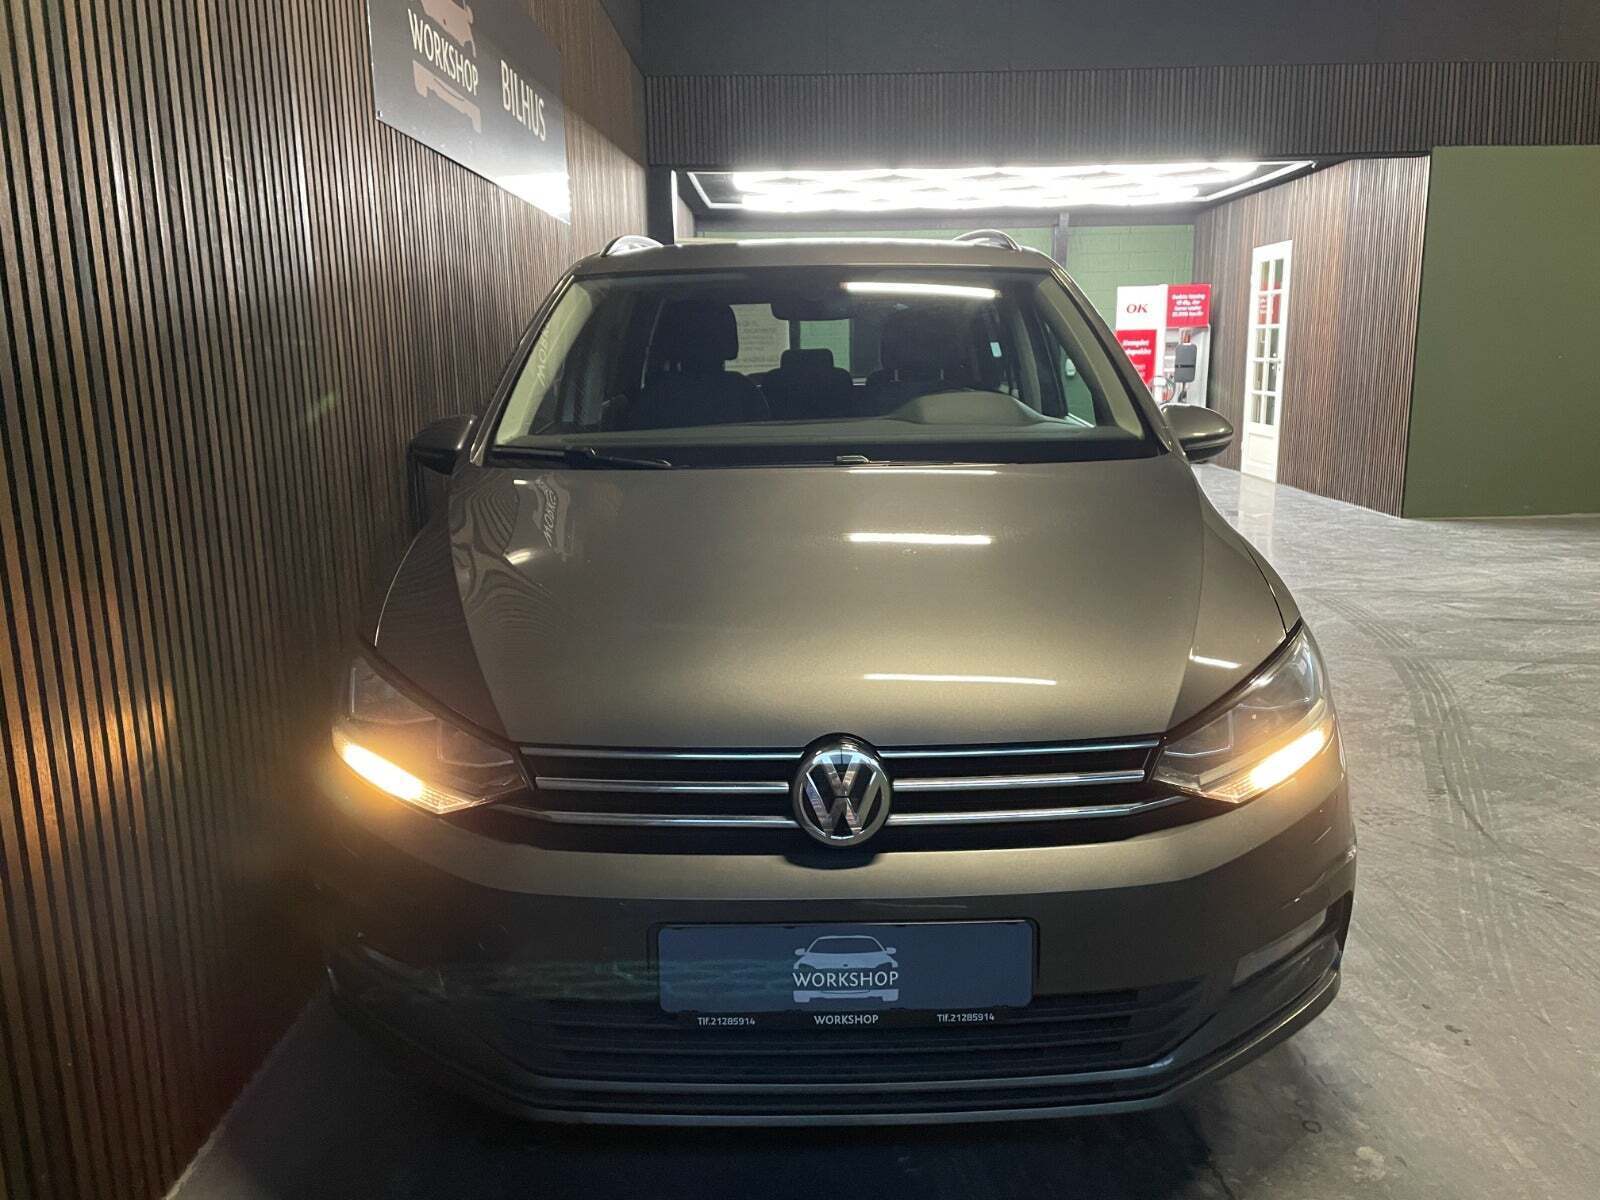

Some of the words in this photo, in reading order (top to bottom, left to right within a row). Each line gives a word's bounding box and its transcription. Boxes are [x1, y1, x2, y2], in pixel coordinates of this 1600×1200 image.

[408, 8, 479, 96] WORKSHOP
[500, 60, 547, 142] BILHUS
[1126, 303, 1149, 314] OK
[792, 970, 900, 989] WORKSHOP
[697, 1016, 756, 1027] Tlf.21285914
[813, 1014, 880, 1026] WORKSHOP
[936, 1012, 996, 1024] Tlf.21285914
